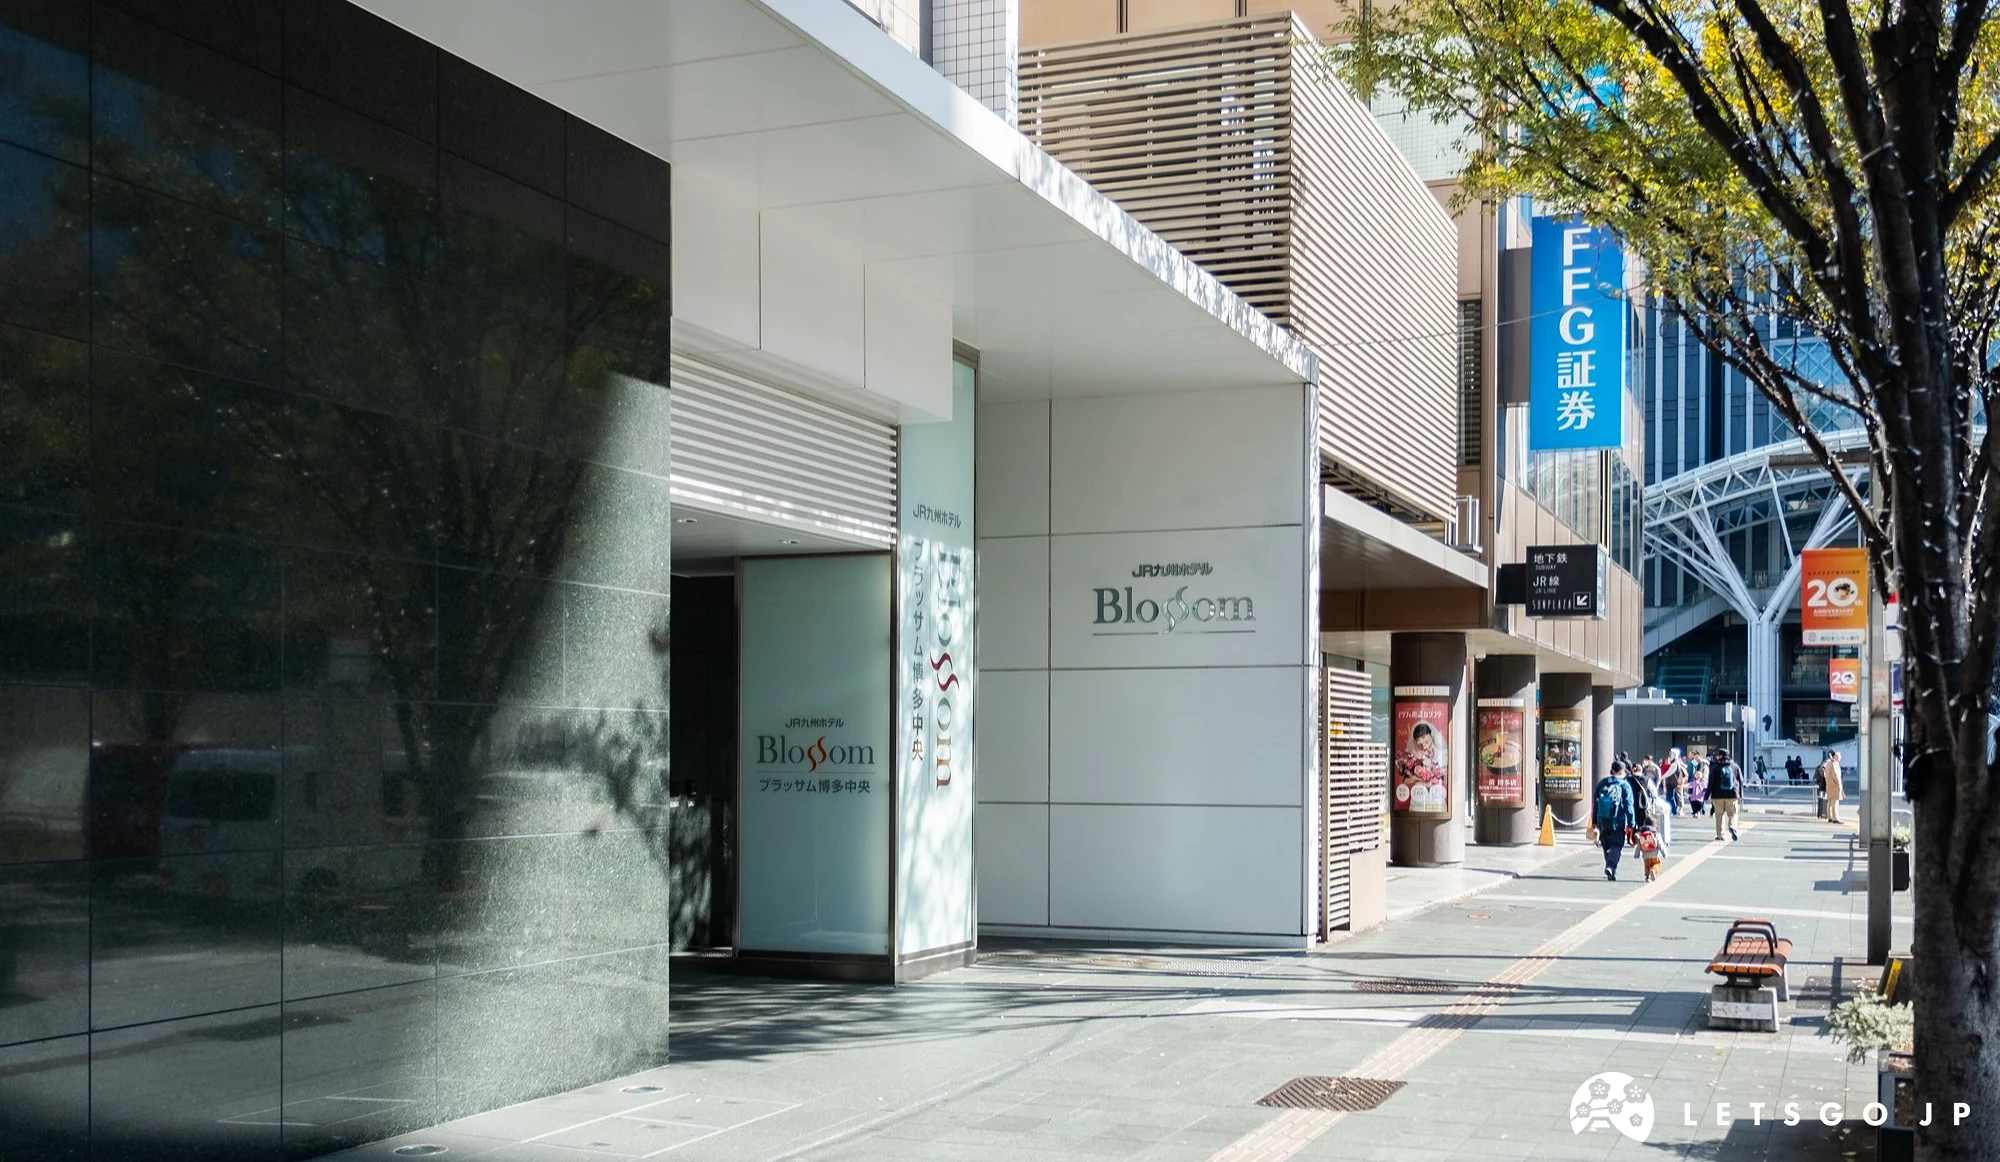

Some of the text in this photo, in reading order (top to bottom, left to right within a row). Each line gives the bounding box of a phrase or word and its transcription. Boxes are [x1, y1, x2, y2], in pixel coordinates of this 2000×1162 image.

[1556, 227, 1596, 431] FFG証券
[912, 503, 962, 529] JR九州ホテル
[1132, 561, 1213, 578] JR九州ホテル
[1533, 552, 1568, 564] 地下鉄
[1092, 585, 1257, 635] Blossom
[911, 540, 924, 762] ブラッサム博多中央
[929, 549, 961, 791] Blossom
[785, 717, 844, 728] JR九州ホテル
[756, 735, 876, 773] Blossom
[759, 778, 871, 794] ブラッサム博多中央
